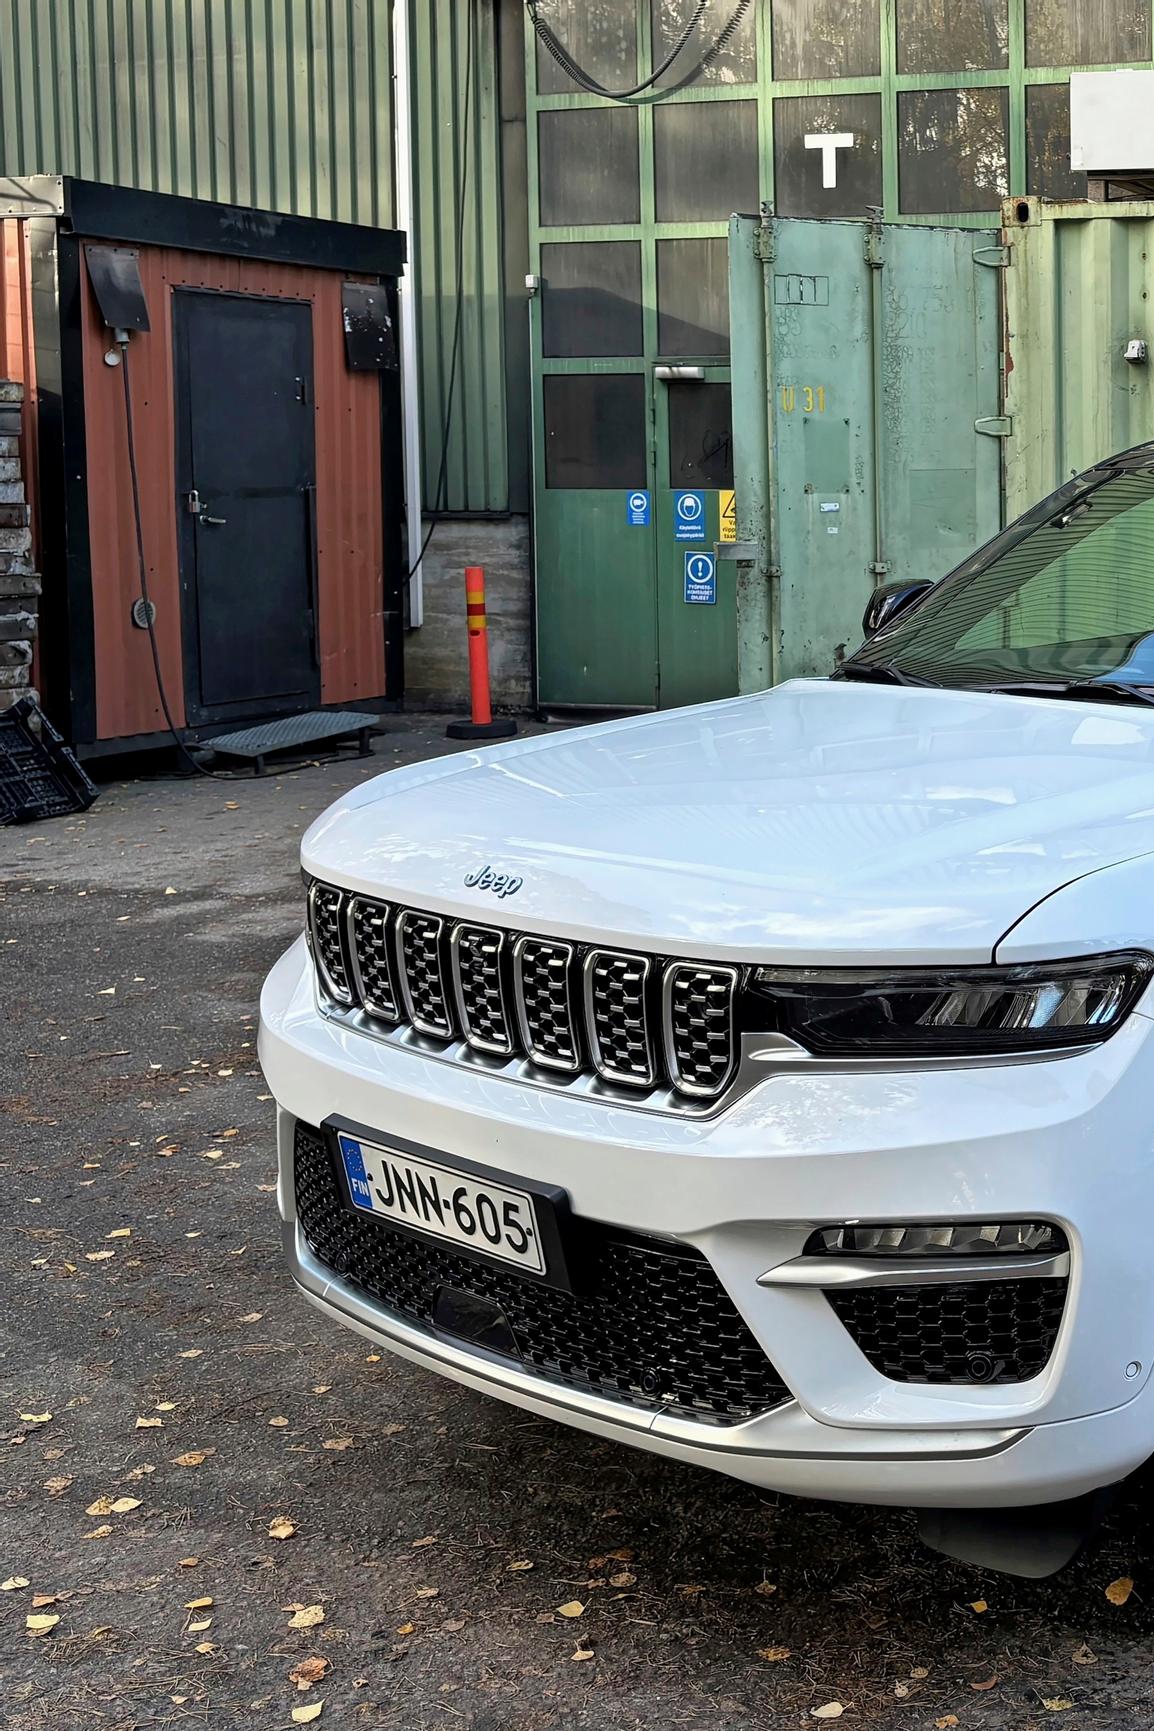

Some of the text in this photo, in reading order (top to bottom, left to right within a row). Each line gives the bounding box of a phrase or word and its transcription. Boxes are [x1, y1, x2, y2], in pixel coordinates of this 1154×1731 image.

[804, 133, 854, 189] T
[802, 384, 826, 414] 31
[463, 864, 523, 899] Jeep
[351, 1177, 370, 1197] FIN
[375, 1159, 529, 1254] JNN-605
